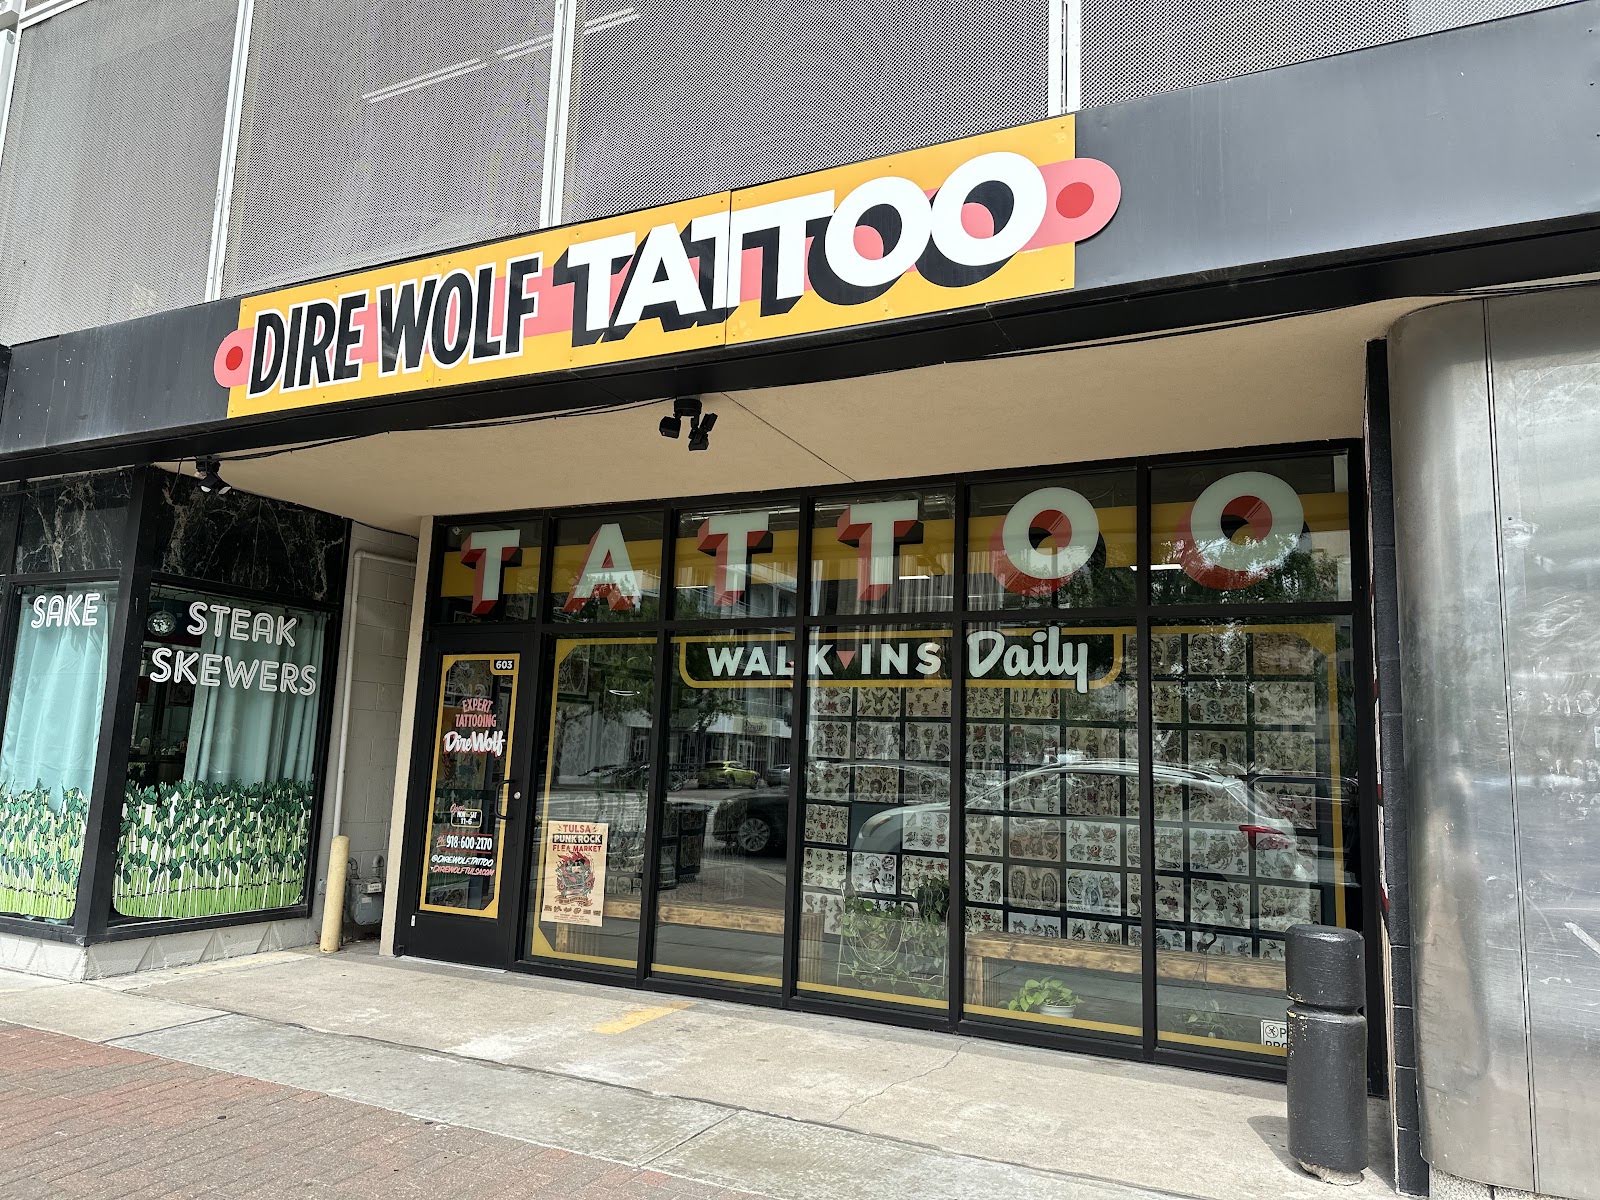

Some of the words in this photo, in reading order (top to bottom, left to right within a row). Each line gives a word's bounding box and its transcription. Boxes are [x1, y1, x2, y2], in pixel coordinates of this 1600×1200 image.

[247, 289, 369, 398] DIRE
[376, 252, 543, 378] WOLF
[558, 151, 1047, 342] TATTOO
[31, 593, 100, 628] SAKE
[187, 601, 297, 647] STEAK
[150, 647, 317, 696] SKEWERS
[495, 660, 513, 670] 603
[967, 625, 1088, 693] Daily
[462, 698, 493, 713] EXPERT
[455, 713, 497, 728] TATTOOING
[554, 834, 577, 843] PUNK
[578, 835, 601, 844] ROCK
[563, 824, 591, 833] TULSA
